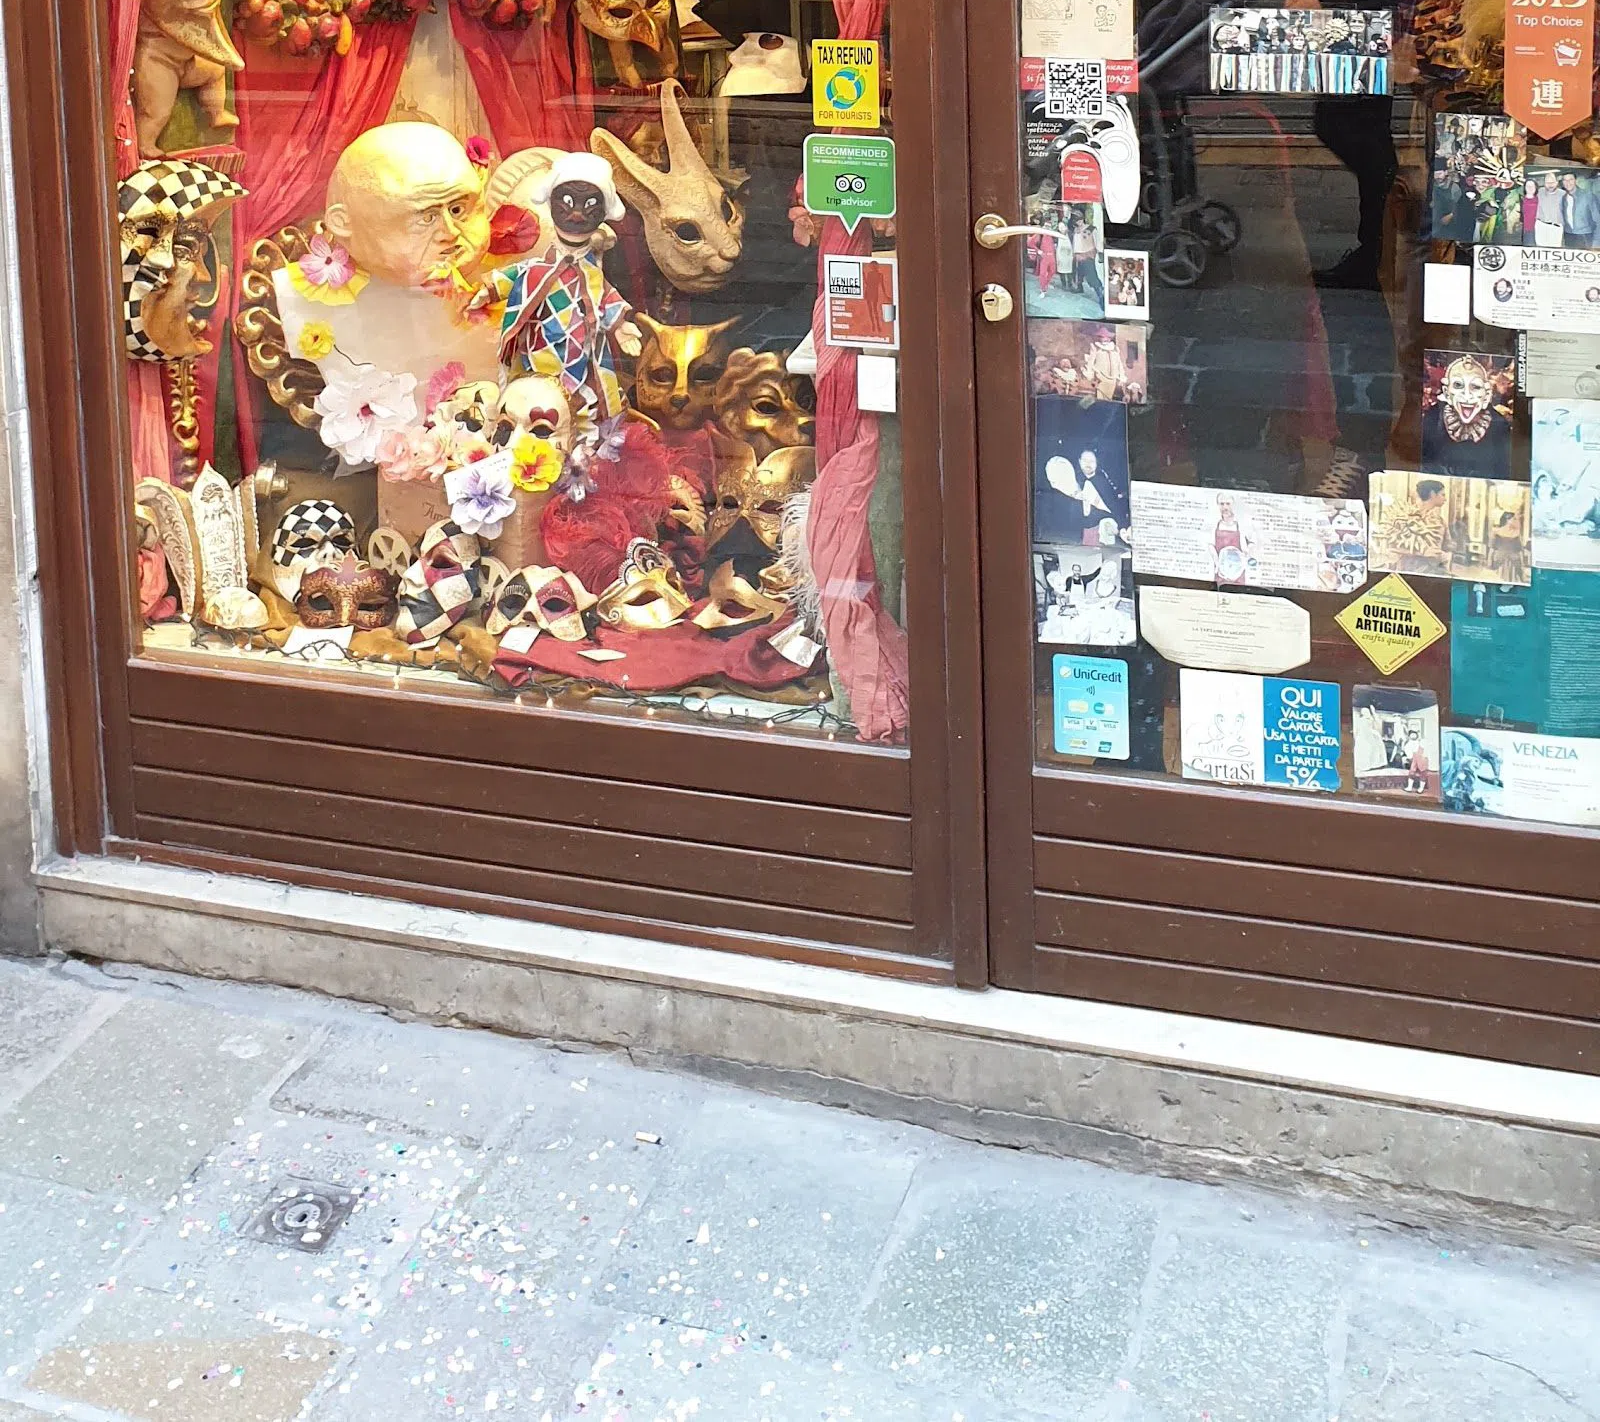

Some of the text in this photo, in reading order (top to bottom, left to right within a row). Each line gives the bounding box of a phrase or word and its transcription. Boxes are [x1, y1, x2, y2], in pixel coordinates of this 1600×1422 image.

[1515, 14, 1583, 27] Top Choice
[817, 46, 873, 65] TAX REFUND
[819, 110, 872, 120] FOR TOURISTS
[812, 146, 888, 159] RECOMMENDED
[826, 195, 873, 207] tripadvisor
[1521, 249, 1600, 264] MITSUKO
[831, 277, 859, 286] VENICE
[1363, 604, 1416, 623] QUALITA'
[1355, 617, 1421, 638] ARTIGIANA
[1361, 632, 1415, 649] crafts quality
[1073, 667, 1122, 683] UniCredit
[1280, 686, 1322, 708] QUI
[1281, 706, 1323, 722] VALORE
[1264, 727, 1339, 747] USA LA CARTA
[1282, 743, 1321, 757] E METTI
[1512, 741, 1578, 760] VENEZIA
[1275, 753, 1333, 769] DA PARTE IL
[1286, 765, 1321, 788] 5%
